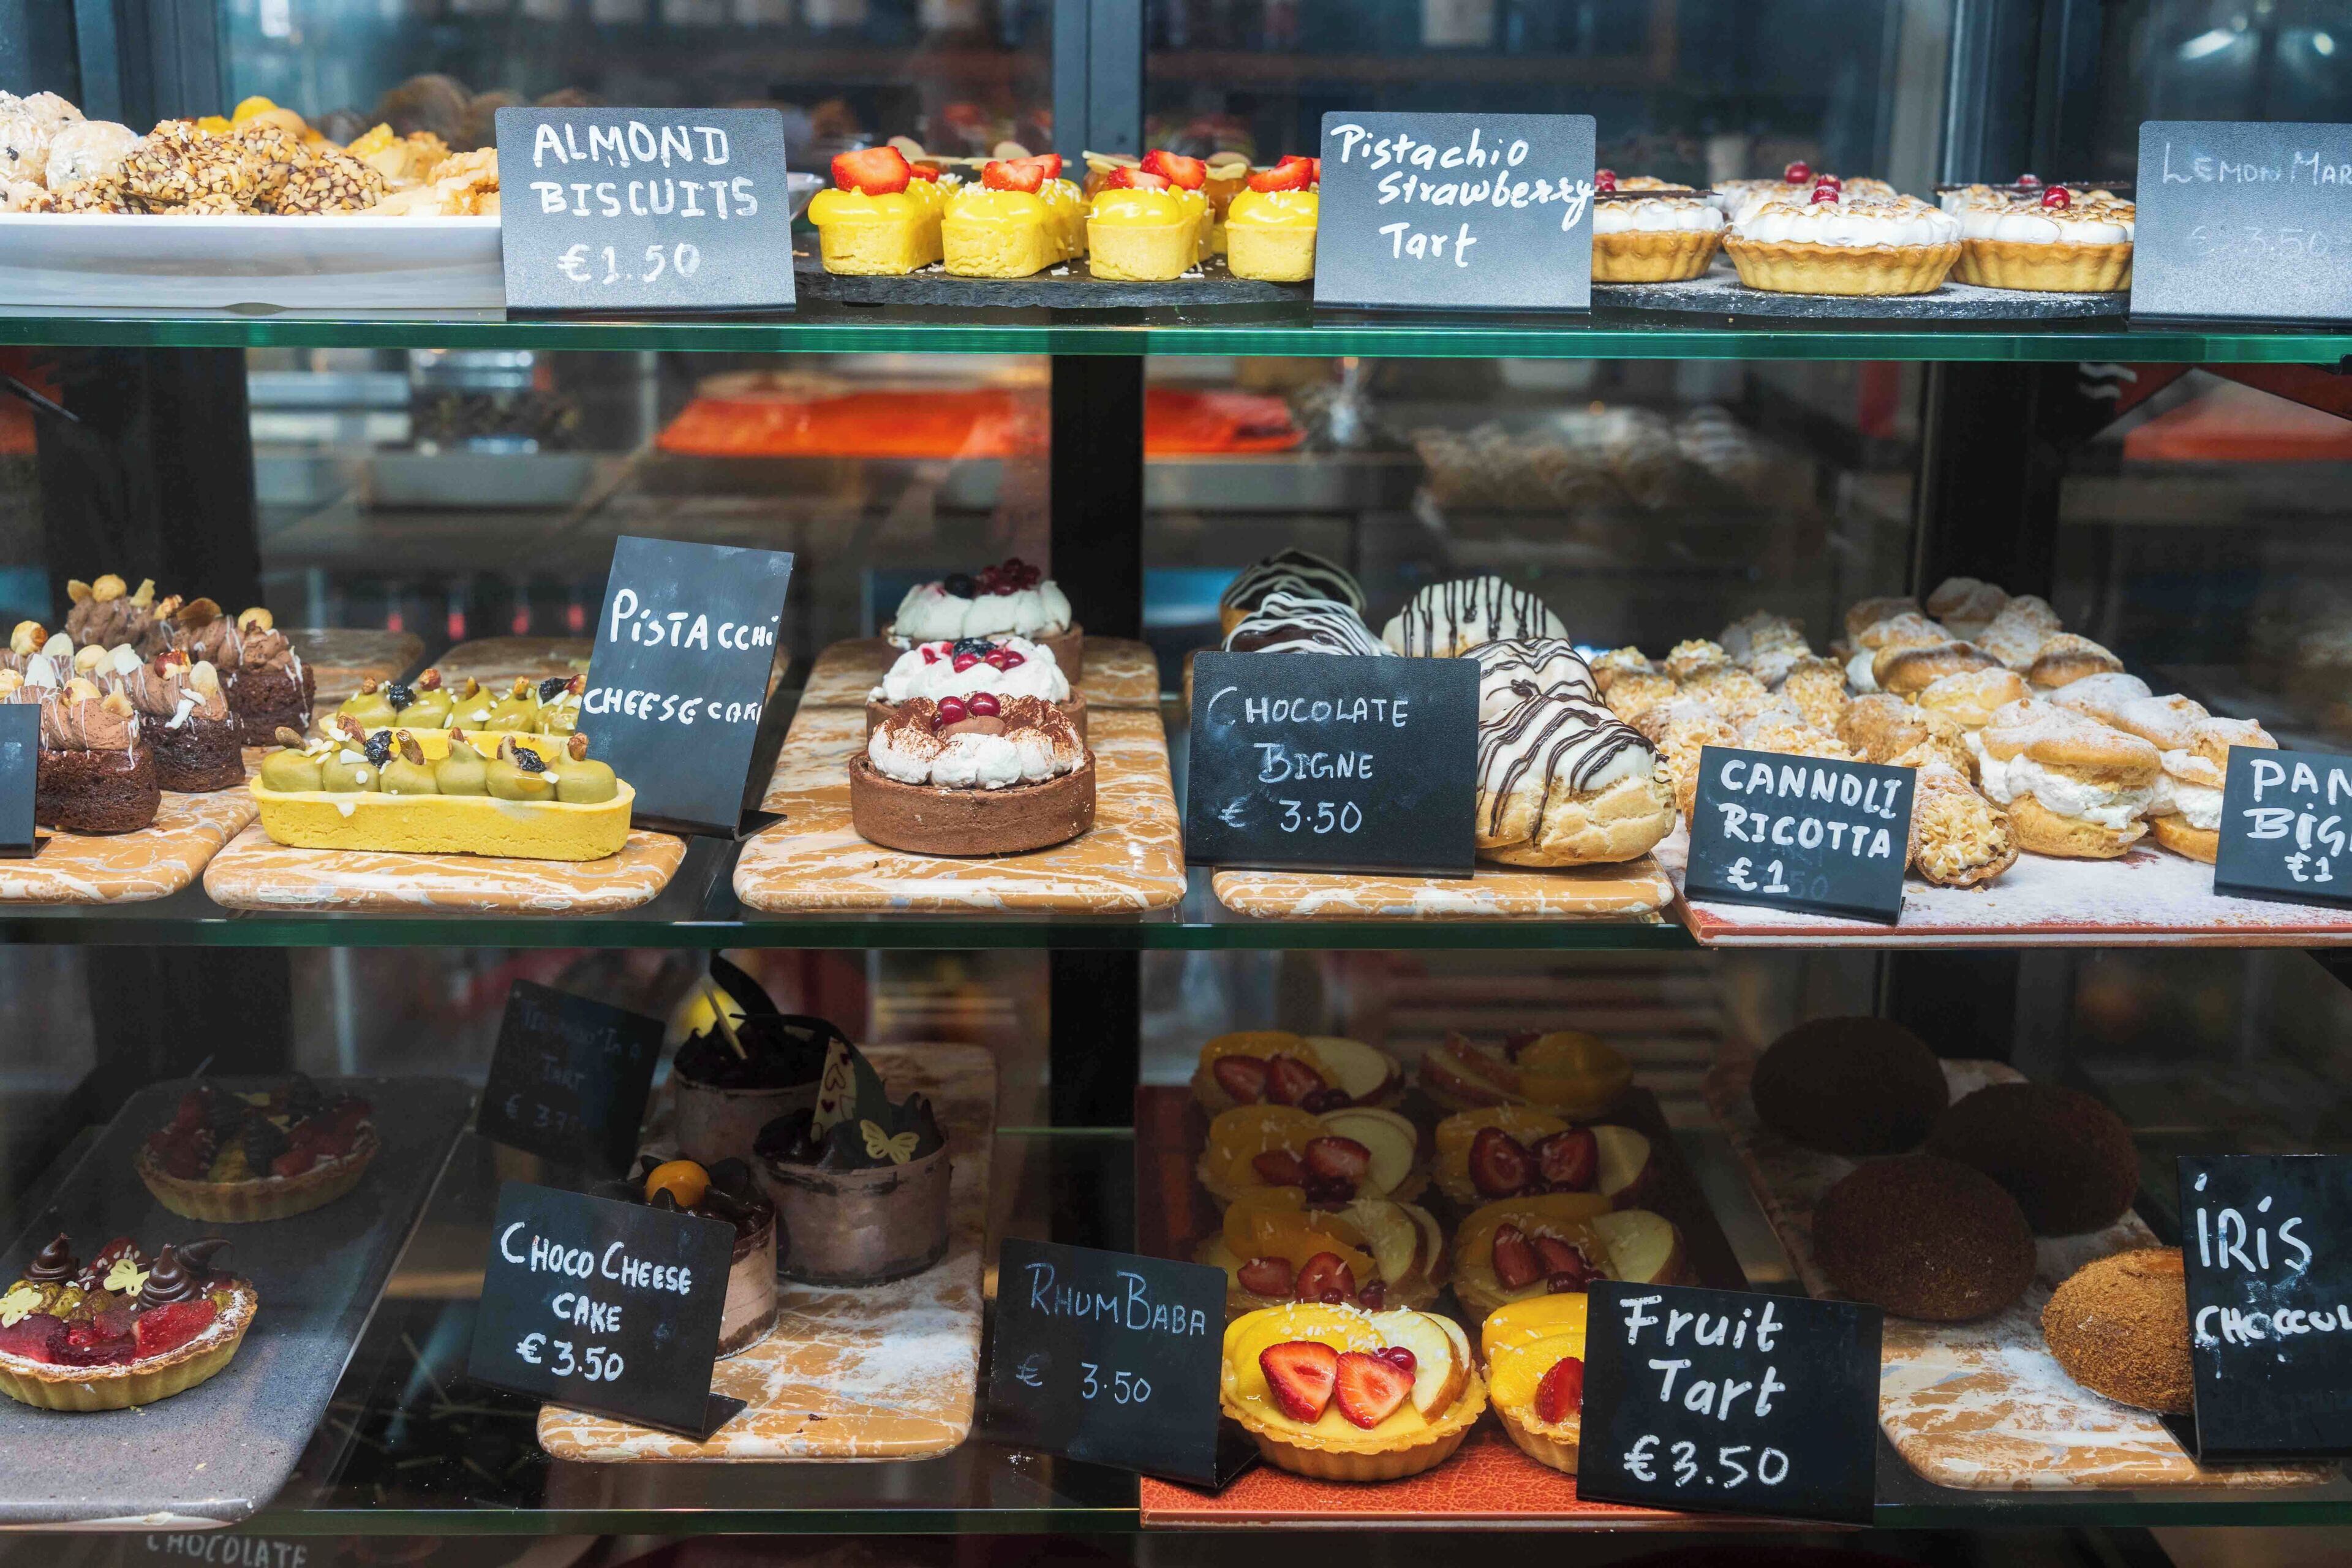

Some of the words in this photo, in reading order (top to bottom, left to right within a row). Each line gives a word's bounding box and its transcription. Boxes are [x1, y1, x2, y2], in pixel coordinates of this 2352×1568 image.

[532, 121, 730, 168] ALMOND
[1330, 124, 1529, 170] Pistachio
[2163, 142, 2282, 184] LEMON
[529, 176, 758, 219] BISCUITS
[1378, 170, 1594, 232] Strawberry
[1379, 222, 1477, 268] Tart
[1207, 686, 1409, 727] CHOCOLATE
[1253, 742, 1373, 783] BIGNE
[1279, 800, 1362, 834] 3.50
[1718, 802, 1891, 858] RICOTTA
[500, 1222, 594, 1279] CHOCO
[601, 1241, 692, 1295] CHEESE
[552, 1292, 623, 1334] CAKE
[1025, 1262, 1119, 1324] RHUM
[1117, 1270, 1206, 1336] BABA
[1619, 1295, 1784, 1352] Fruit
[1081, 1362, 1152, 1404] 3.50
[1648, 1359, 1786, 1421] Tart
